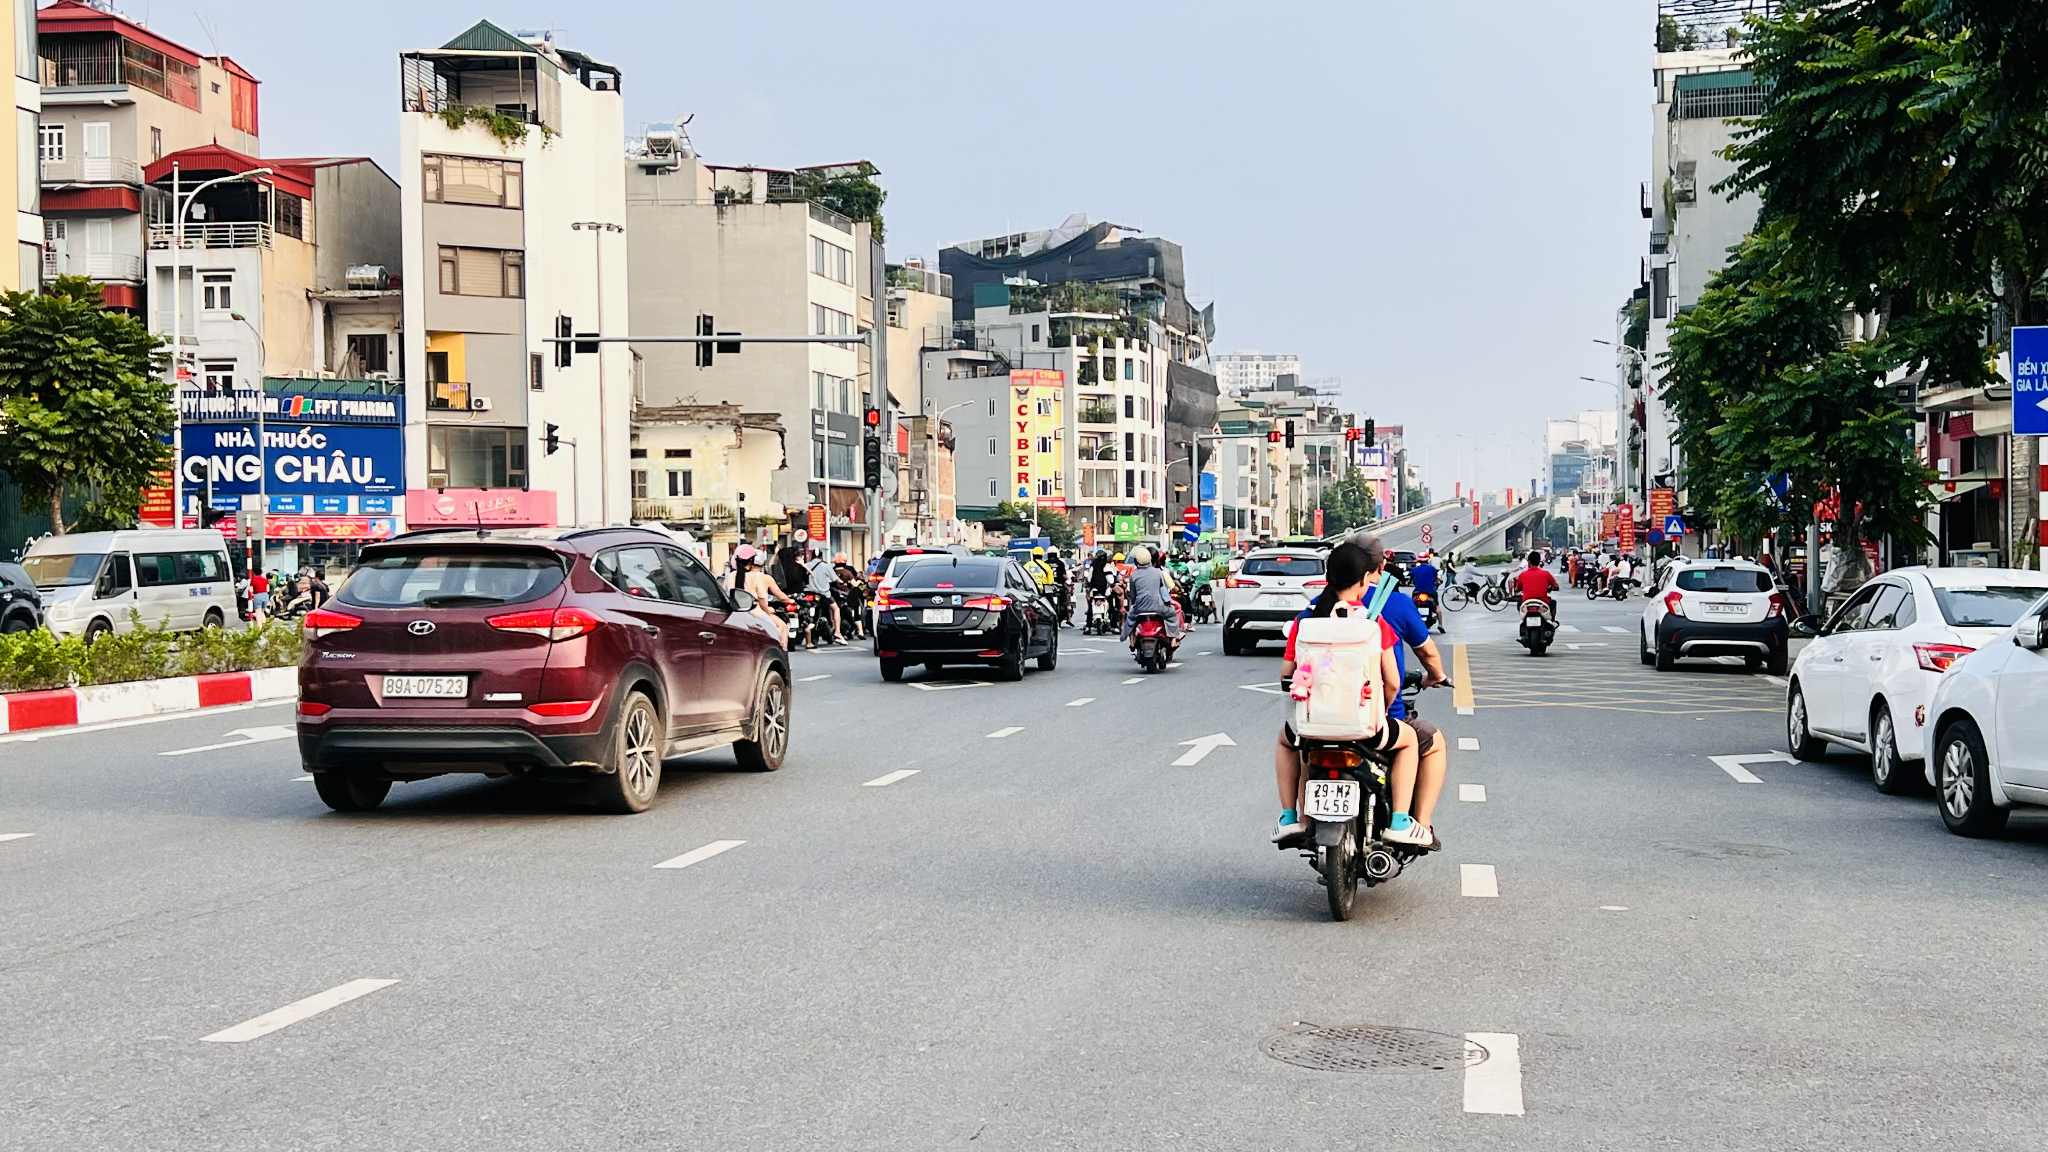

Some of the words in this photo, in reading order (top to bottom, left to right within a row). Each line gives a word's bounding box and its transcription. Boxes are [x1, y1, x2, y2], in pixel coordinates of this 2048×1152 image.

[2016, 378, 2033, 392] GIA
[341, 400, 396, 417] PHARMA
[215, 427, 256, 447] NHÀ
[263, 426, 327, 449] THUỐC
[275, 449, 373, 484] CHÂU
[1315, 799, 1350, 814] 1456
